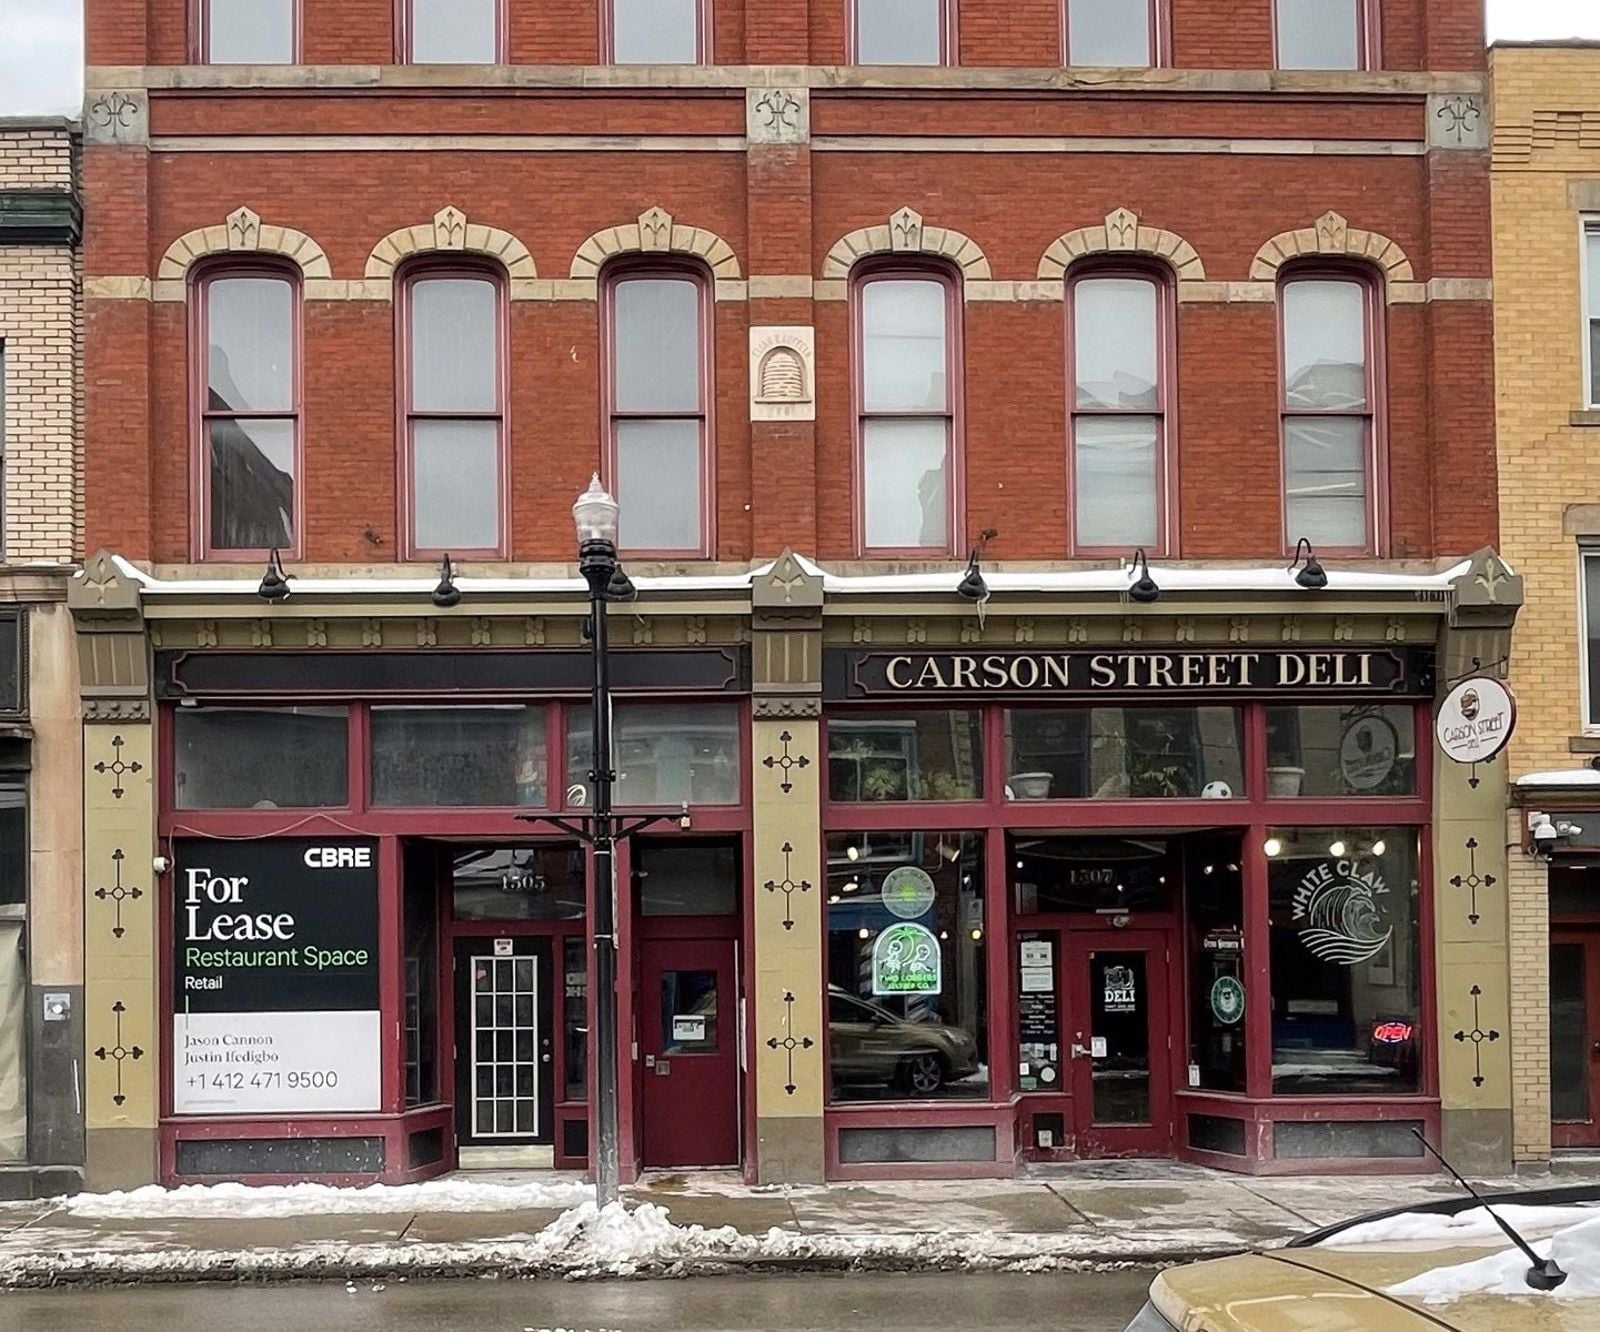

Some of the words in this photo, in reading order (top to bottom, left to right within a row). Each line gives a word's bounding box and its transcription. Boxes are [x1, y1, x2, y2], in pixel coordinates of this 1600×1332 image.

[885, 655, 1072, 688] CARSON
[1090, 654, 1259, 687] STREET
[1276, 653, 1373, 686] DELI
[1443, 723, 1478, 743] CARSON
[1478, 712, 1505, 735] STREET
[304, 847, 371, 868] CBRE
[502, 875, 545, 890] 1505
[1070, 868, 1113, 884] 1507
[185, 868, 249, 903] For
[1292, 863, 1333, 920] WHITE
[1336, 860, 1391, 895] CLAW
[185, 905, 295, 941] Lease
[186, 947, 299, 967] Restaurant
[304, 946, 369, 970] Space
[185, 976, 223, 990] Retail
[1104, 990, 1136, 1002] DELI
[184, 1035, 219, 1048] Jason
[222, 1034, 273, 1046] Cannon
[1374, 1025, 1412, 1040] OPEN
[184, 1051, 222, 1065] Justin
[225, 1050, 279, 1064] Ifedigbo
[187, 1073, 206, 1089] +1
[212, 1072, 244, 1089] 412
[250, 1072, 281, 1089] 471
[287, 1071, 338, 1089] 9500
